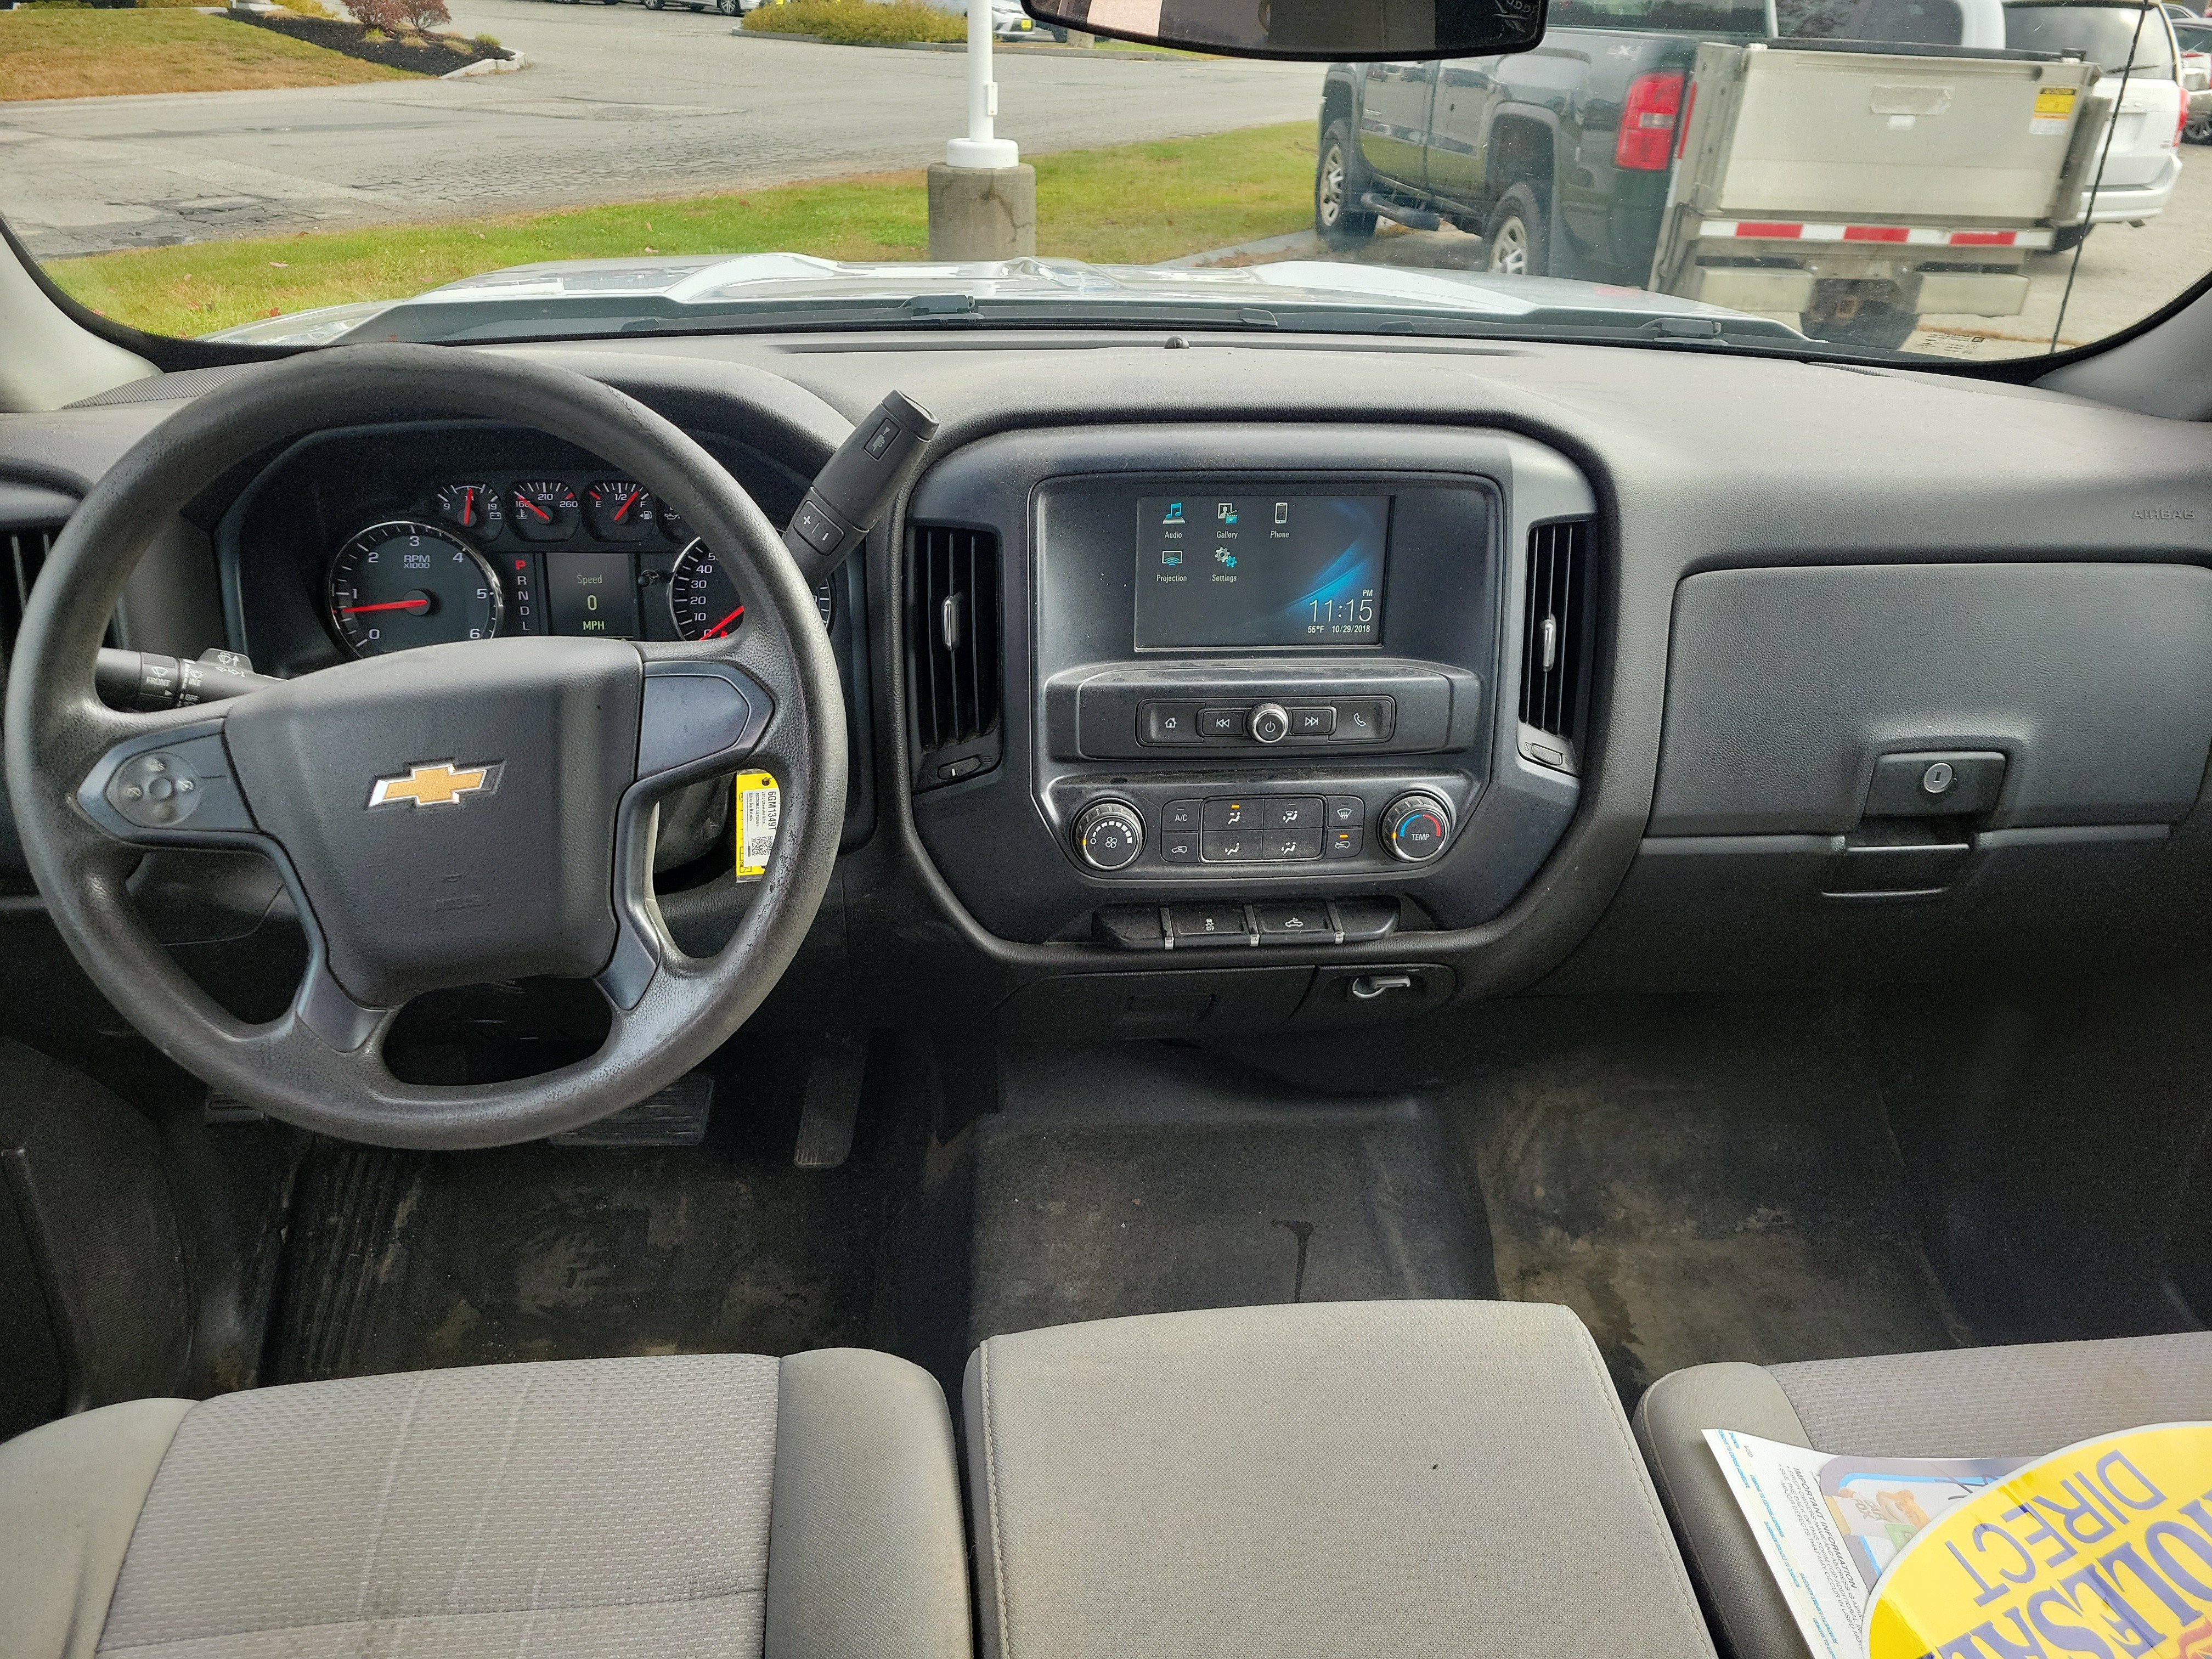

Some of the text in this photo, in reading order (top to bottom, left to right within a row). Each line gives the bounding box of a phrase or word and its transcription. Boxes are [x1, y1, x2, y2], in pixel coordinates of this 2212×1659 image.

[2132, 509, 2194, 520] AIRBAG
[1216, 531, 1238, 540] Gallery
[410, 536, 420, 546] 3
[368, 552, 379, 563] 2
[453, 552, 464, 562] 4
[515, 560, 526, 570] P
[696, 565, 712, 573] 40
[517, 576, 527, 585] R
[577, 575, 602, 585] Speed
[691, 580, 707, 589] 30
[352, 589, 357, 599] 1
[477, 589, 487, 599] 5
[518, 591, 528, 600] N
[587, 595, 597, 611] 0
[520, 606, 529, 615] D
[1310, 599, 1373, 622] 11:15
[523, 622, 530, 630] L
[583, 621, 605, 630] MPH
[1331, 625, 1370, 633] 10/29/2018
[369, 629, 380, 639] 0
[470, 629, 480, 639] 6
[146, 677, 172, 686] FRONT
[189, 678, 202, 686] INT
[768, 791, 776, 831] 6GM1349T
[1411, 833, 1430, 841] TEMP
[1788, 1470, 1801, 1489] PRIOR
[1798, 1492, 1816, 1519] OWNERS
[1813, 1521, 1826, 1539] NAME
[1822, 1542, 1833, 1555] AND
[1831, 1559, 1850, 1589] ADDRESS
[1793, 1468, 1857, 1588] IMPORTANT INFORMATION
[1945, 1449, 2167, 1607] DIRECT
[1779, 1468, 1789, 1480] SEE
[1787, 1483, 1797, 1494] THE
[1793, 1496, 1805, 1511] BACK
[1803, 1515, 1812, 1524] OF
[1808, 1526, 1819, 1539] THIS
[1816, 1542, 1829, 1561] FORM
[1826, 1564, 1837, 1578] FOR
[1834, 1579, 1858, 1620] ADDITIONAL
[1780, 1482, 1795, 1504] MAJOR
[1792, 1506, 1810, 1536] DEFECTS
[1808, 1538, 1820, 1554] THAT
[1816, 1556, 1827, 1569] MAY
[1824, 1572, 1840, 1597] OCCUR
[1842, 1610, 1855, 1628] USED
